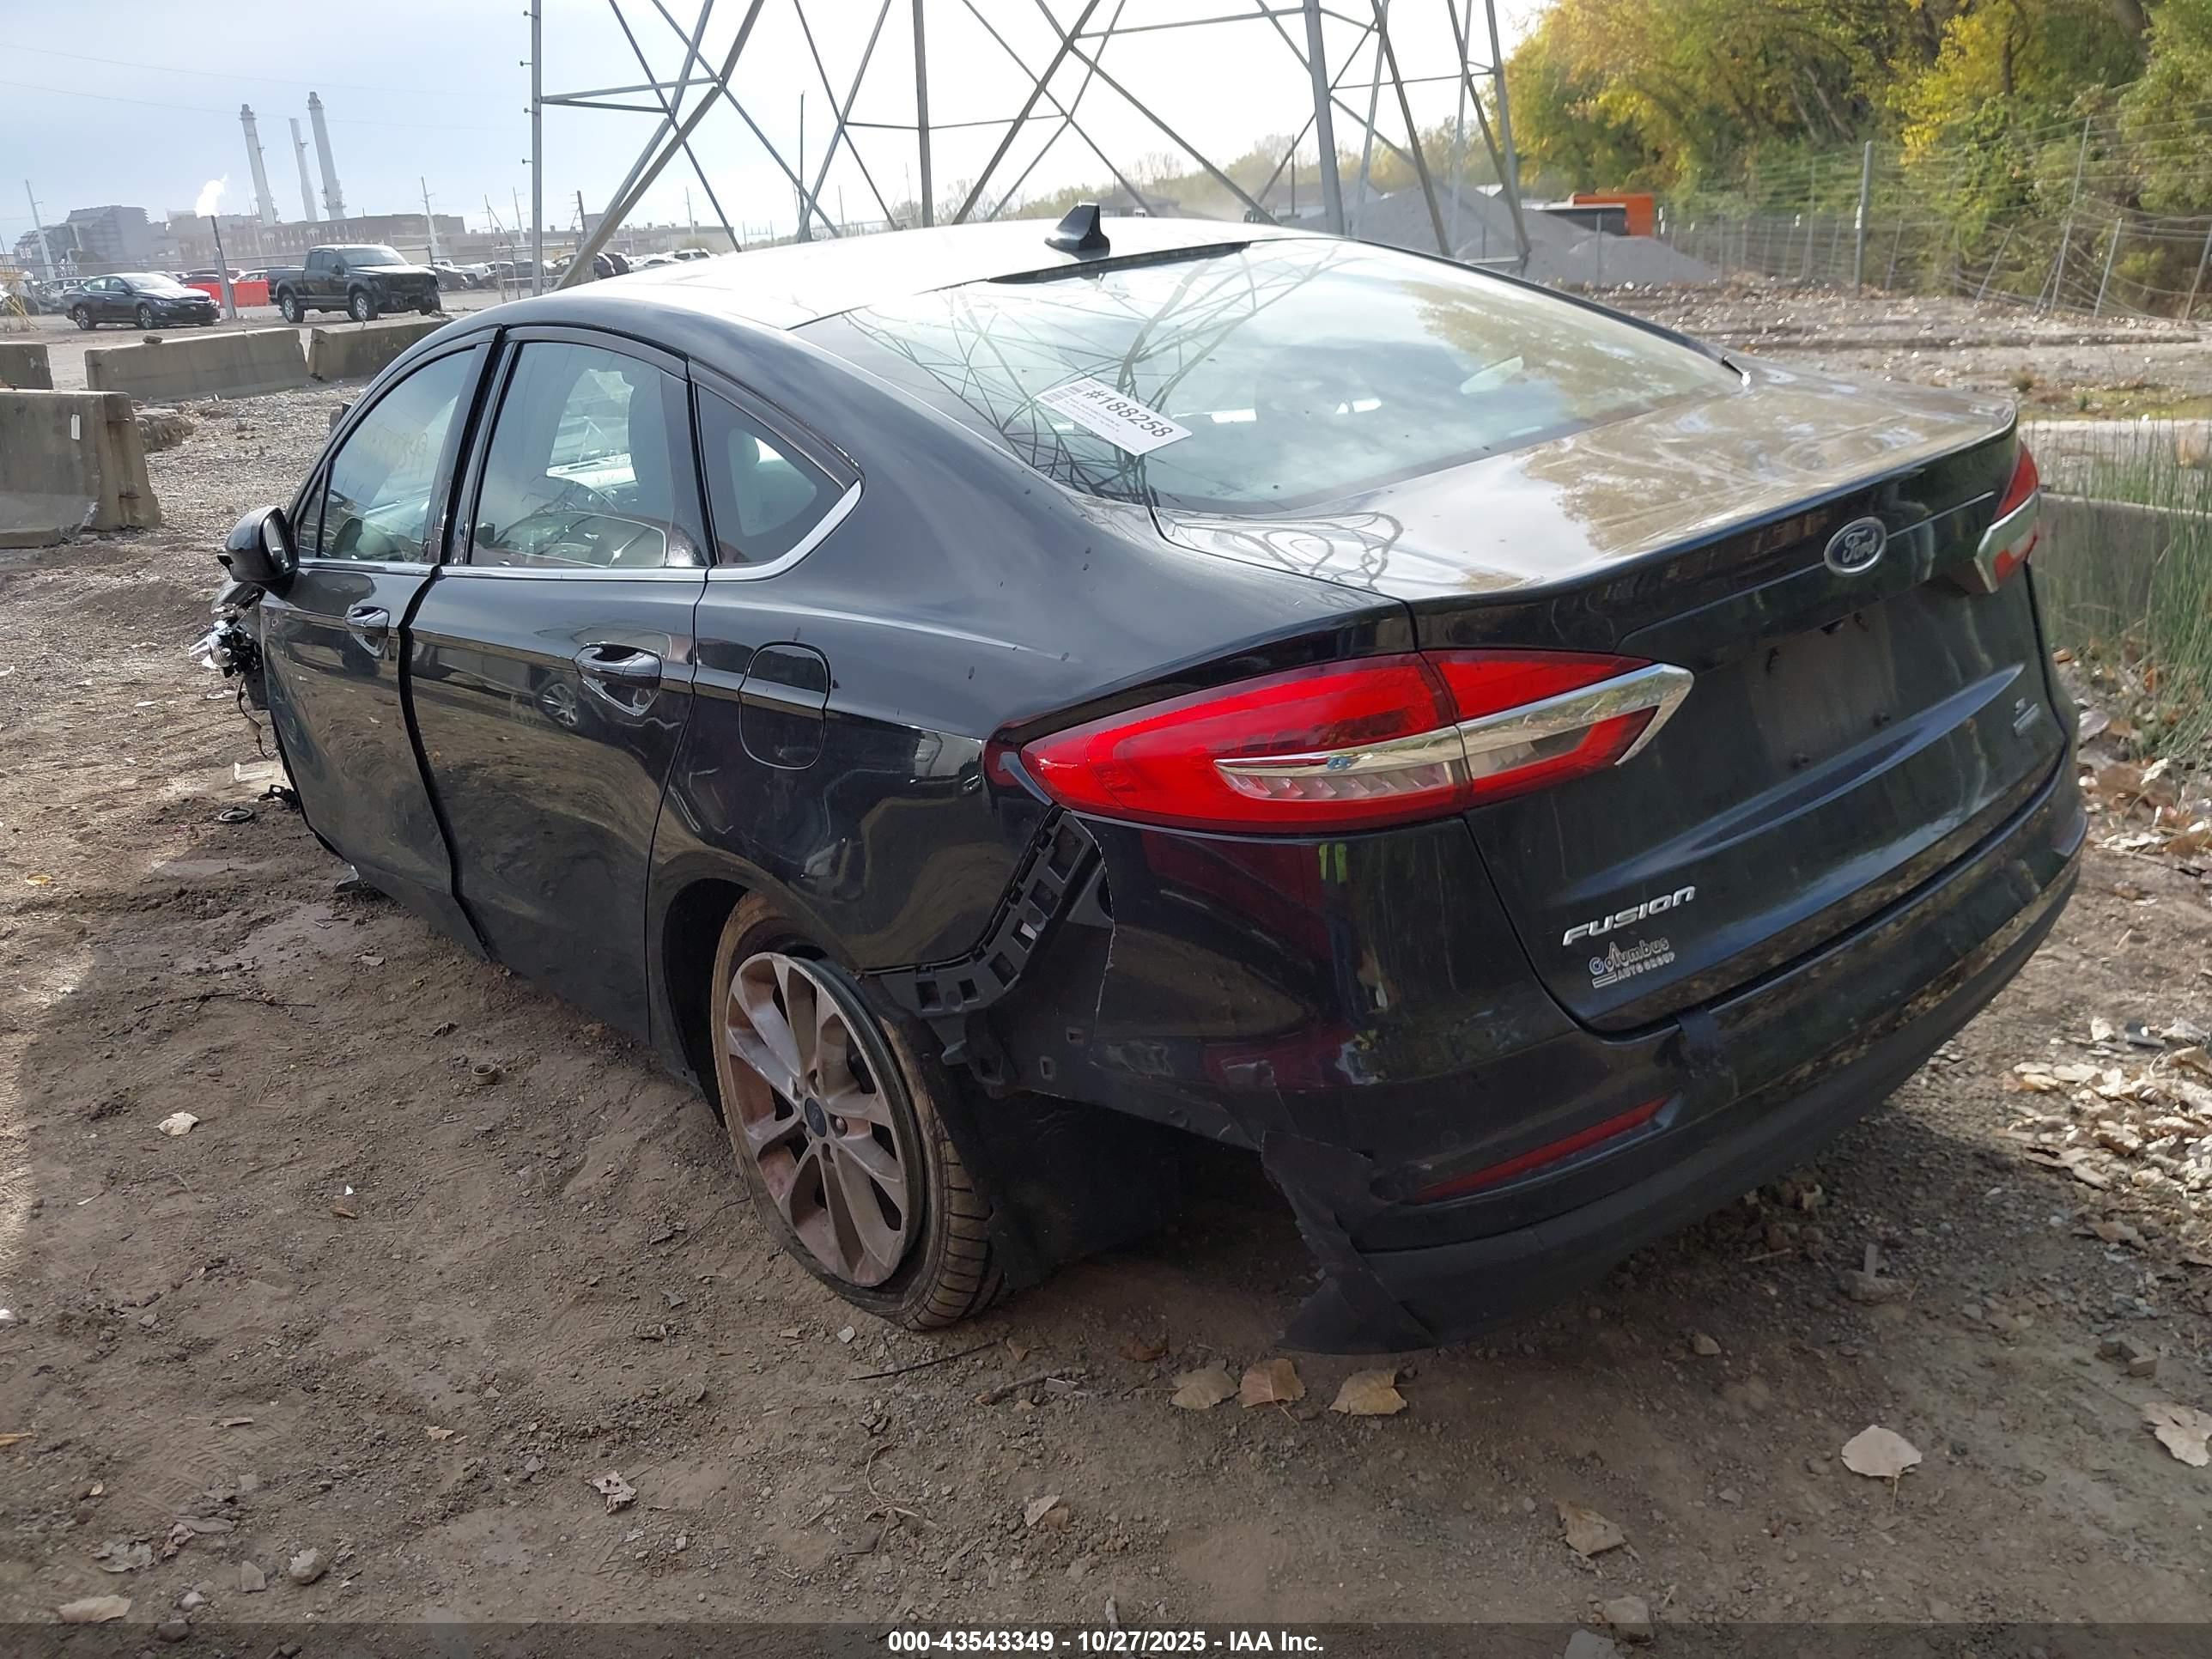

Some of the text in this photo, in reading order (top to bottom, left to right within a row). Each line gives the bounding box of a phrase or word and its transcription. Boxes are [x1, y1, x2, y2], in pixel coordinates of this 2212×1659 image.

[1082, 389, 1174, 437] #188258
[1842, 529, 1878, 563] Ford
[1589, 937, 1669, 975] Columbus
